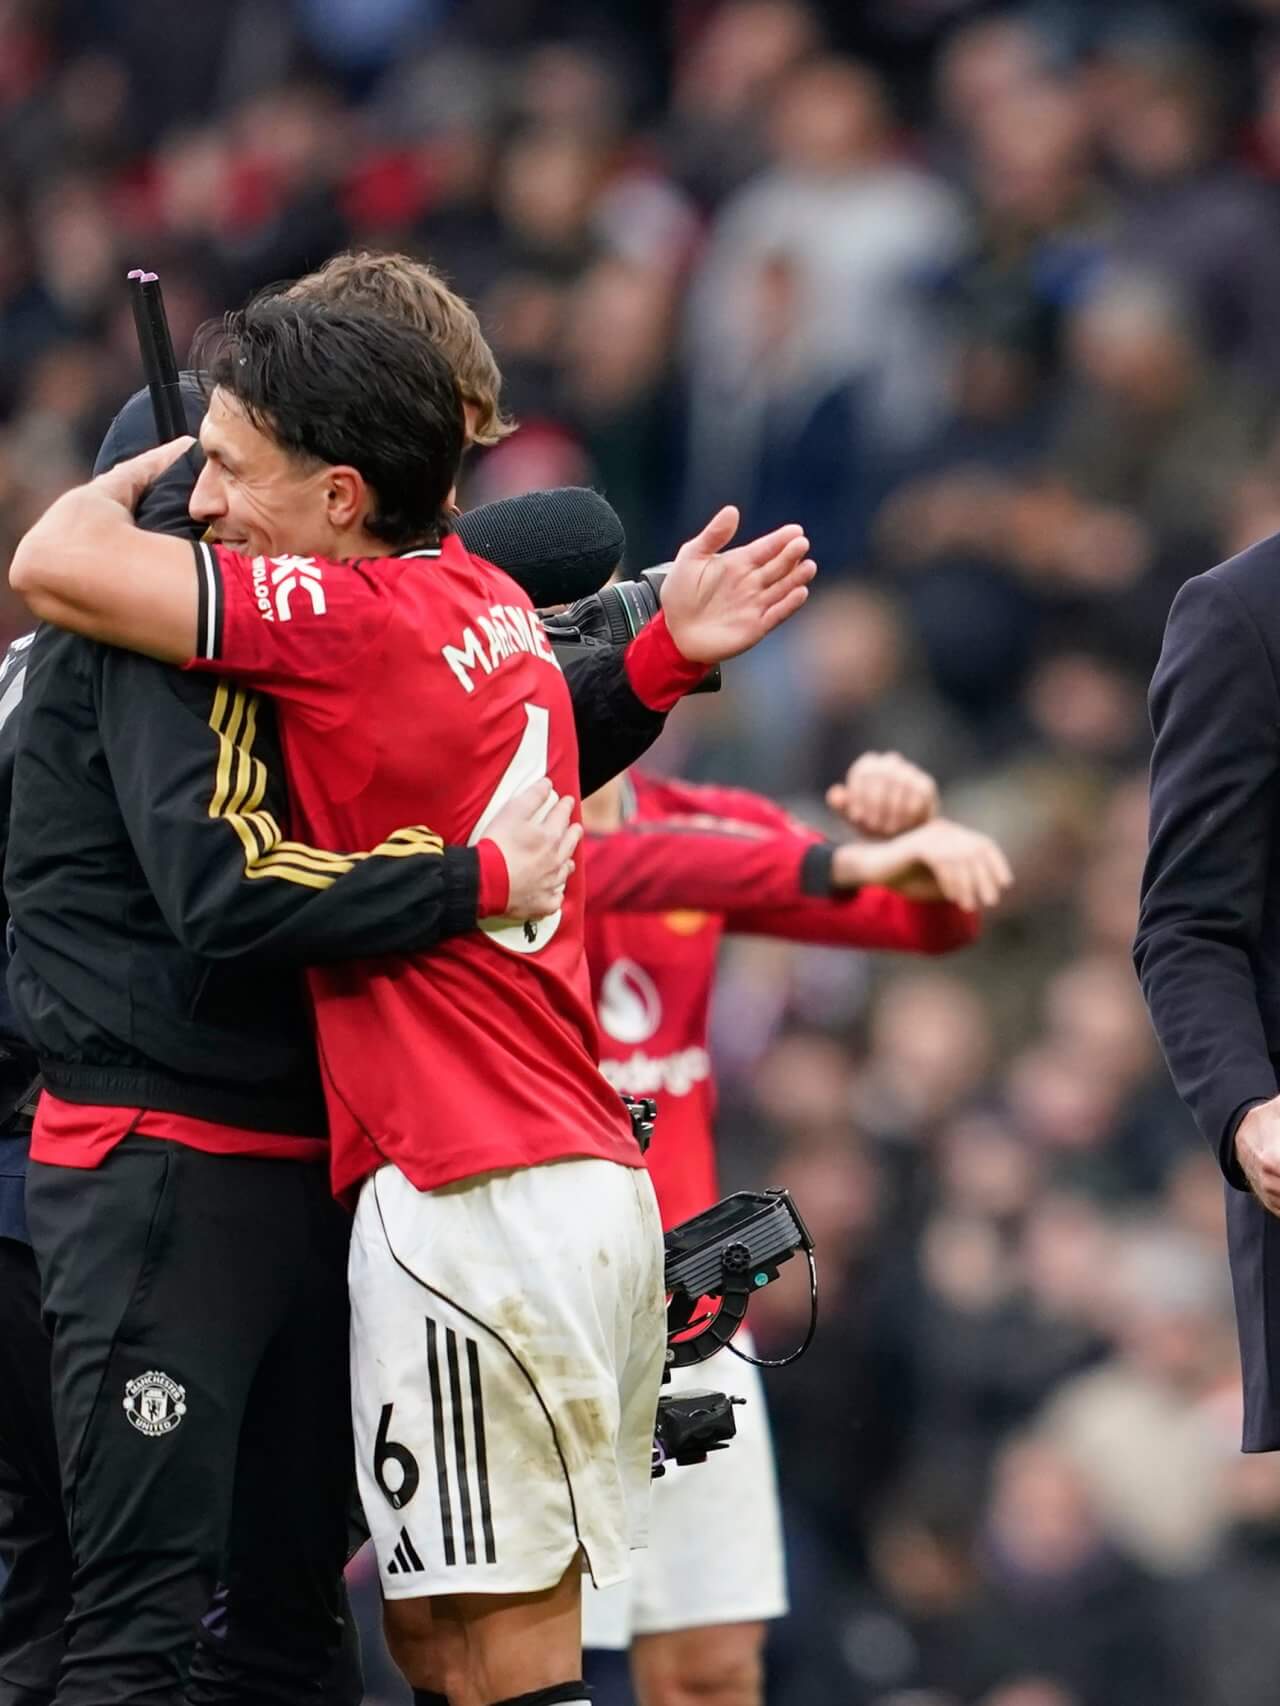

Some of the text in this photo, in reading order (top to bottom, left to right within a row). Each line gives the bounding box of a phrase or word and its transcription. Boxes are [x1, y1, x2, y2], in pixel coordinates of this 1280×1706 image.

[130, 1376, 181, 1400] MANCHESTER
[135, 1418, 172, 1432] UNITED
[373, 1402, 420, 1511] 6
